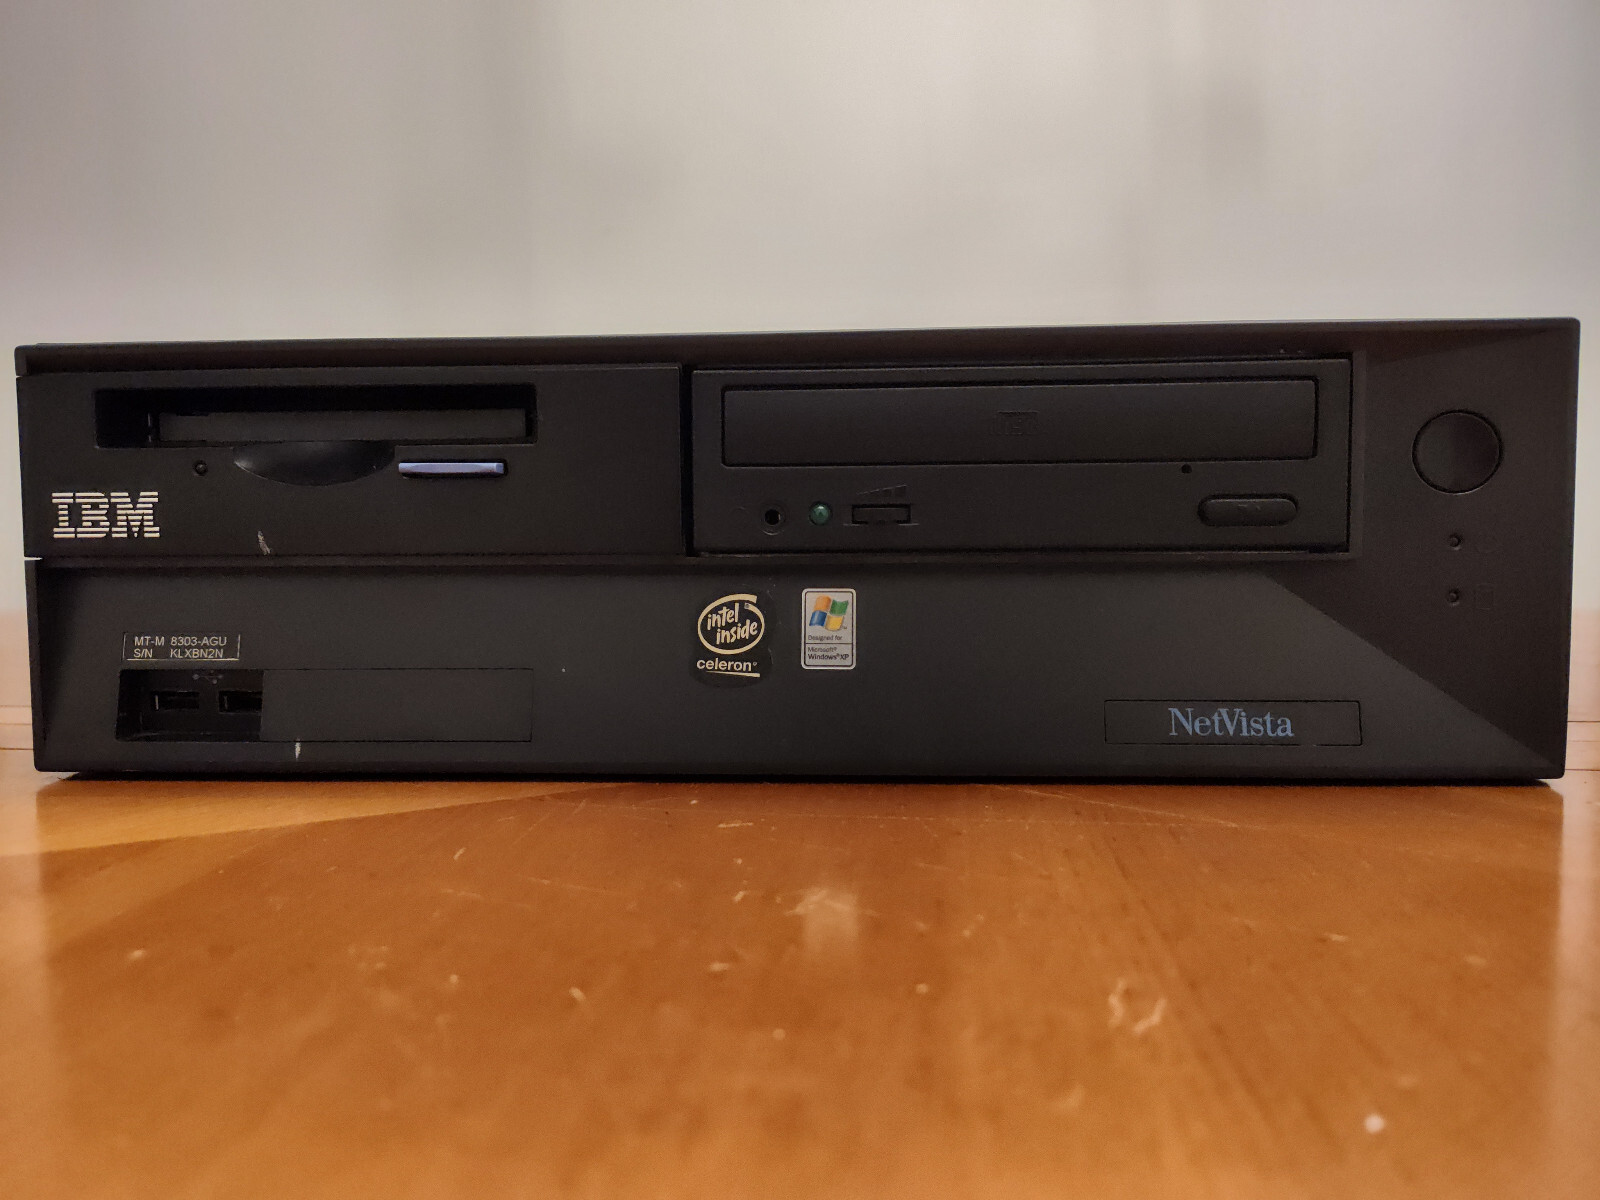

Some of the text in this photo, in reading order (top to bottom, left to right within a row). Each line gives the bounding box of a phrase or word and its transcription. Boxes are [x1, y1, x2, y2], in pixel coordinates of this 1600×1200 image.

[51, 491, 160, 539] IBM
[706, 602, 740, 631] intel
[134, 636, 227, 646] MT-M 8303-AGU
[716, 619, 758, 645] inside
[807, 634, 834, 642] Designed
[133, 648, 224, 658] S/N KLXBN2N
[1167, 707, 1295, 737] NetVista
